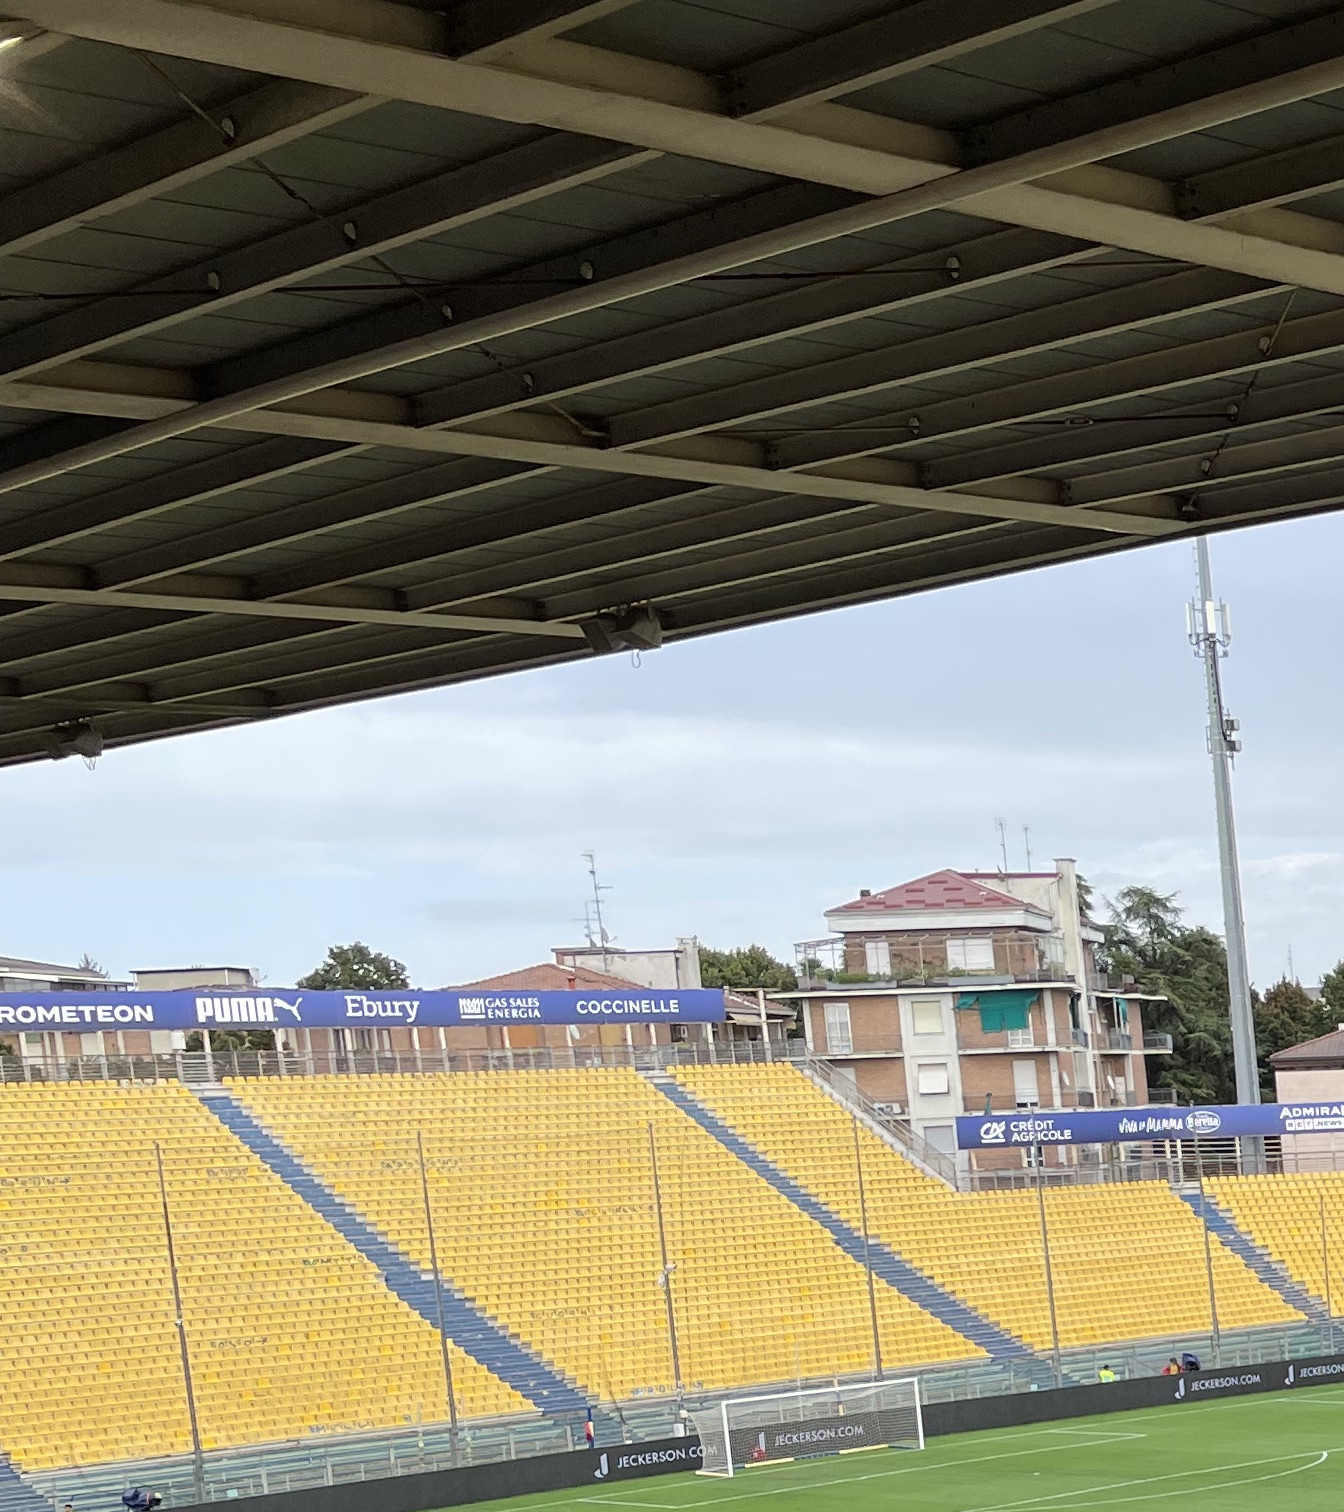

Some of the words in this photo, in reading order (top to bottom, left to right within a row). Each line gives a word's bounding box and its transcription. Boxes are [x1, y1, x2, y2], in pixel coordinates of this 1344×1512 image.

[195, 997, 274, 1022] PUMA
[344, 995, 420, 1023] Ebury
[485, 998, 508, 1008] GAS
[509, 997, 540, 1008] SALES
[576, 1000, 680, 1014] COCCINELLE
[487, 1007, 541, 1019] ENERGIA
[1010, 1119, 1055, 1132] CRÉDIT
[1011, 1129, 1072, 1143] AGRICOLE
[1191, 1374, 1261, 1392] JECKERSON.COM
[774, 1424, 864, 1447] JECKERSON.COM
[617, 1444, 718, 1469] JECKERSON.COM
